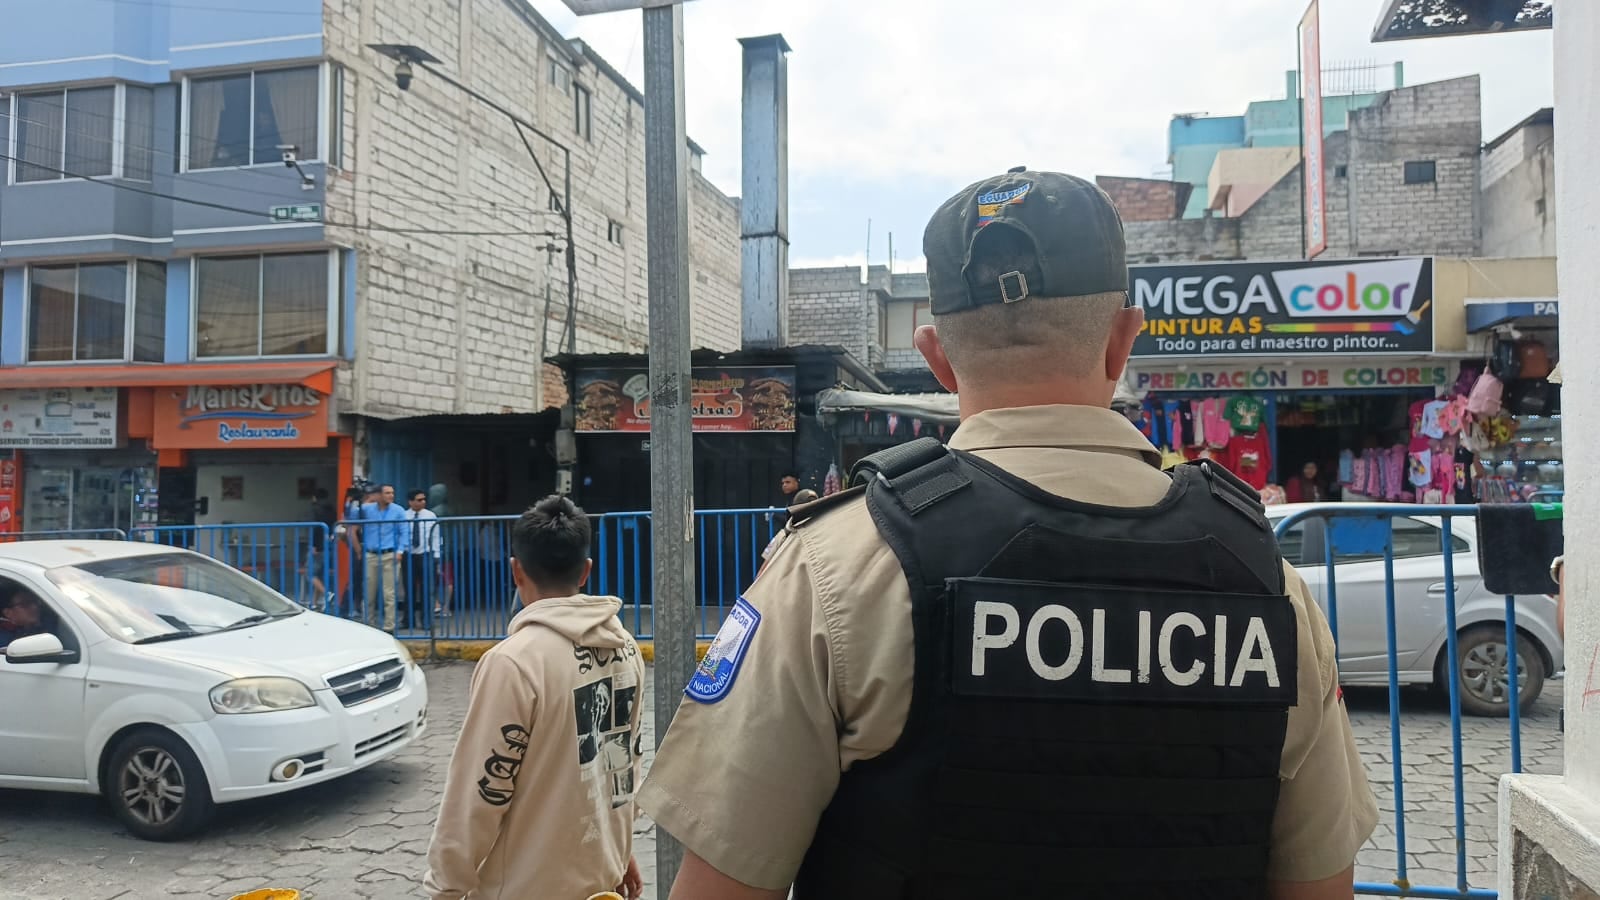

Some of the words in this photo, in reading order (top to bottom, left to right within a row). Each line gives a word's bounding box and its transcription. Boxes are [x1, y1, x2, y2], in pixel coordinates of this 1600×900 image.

[1134, 274, 1278, 315] MEGA
[1289, 272, 1411, 312] color
[1156, 337, 1196, 352] Todo
[1200, 341, 1236, 354] para
[1240, 336, 1256, 350] el
[1260, 335, 1328, 350] maestro
[1333, 334, 1399, 352] pintor...
[1137, 367, 1288, 389] PREPARACIÓN
[1302, 369, 1329, 386] DE
[1342, 366, 1447, 386] COLORES
[218, 421, 299, 442] Restaurante
[971, 600, 1281, 688] POLICIA
[692, 671, 730, 694] NACIONAL
